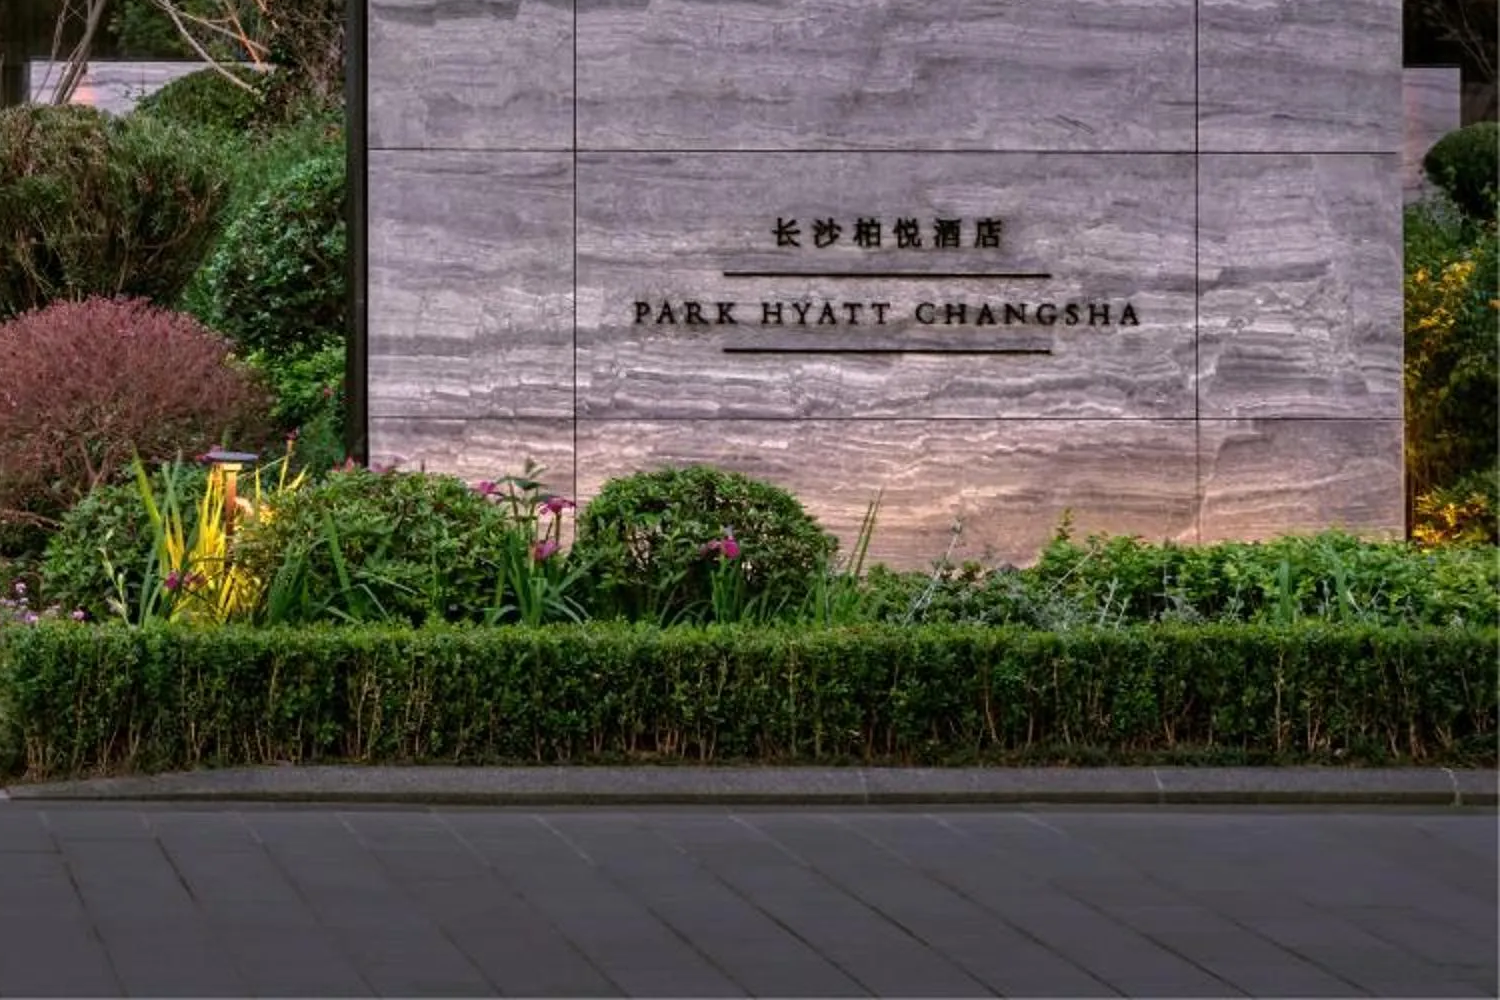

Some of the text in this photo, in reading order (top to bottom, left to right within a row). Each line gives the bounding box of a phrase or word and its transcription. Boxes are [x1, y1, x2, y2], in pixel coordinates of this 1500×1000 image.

[771, 216, 1003, 249] 长沙柏悦酒店
[634, 301, 1141, 326] PARK HYATT CHANGSHA
